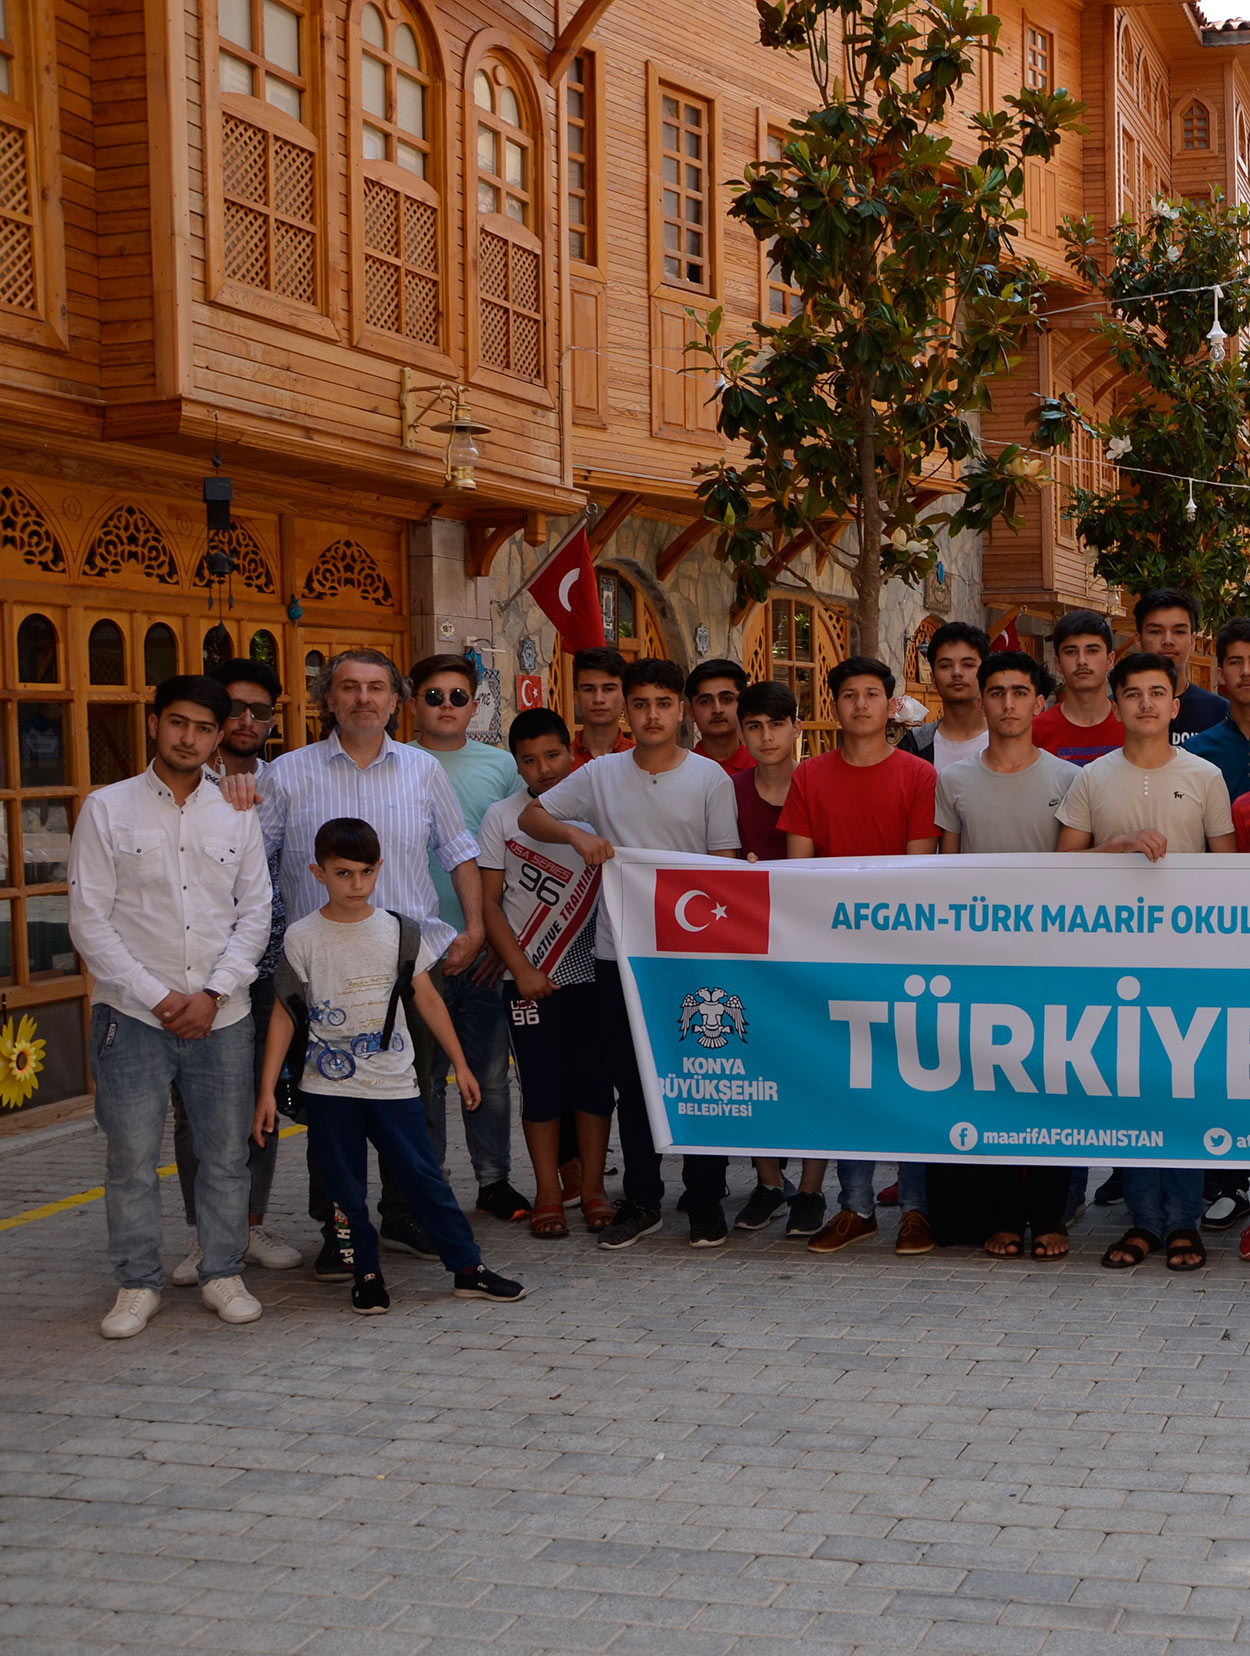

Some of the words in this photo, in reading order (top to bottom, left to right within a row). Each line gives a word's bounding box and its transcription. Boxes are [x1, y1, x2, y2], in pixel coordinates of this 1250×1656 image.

[510, 841, 530, 860] USA
[532, 854, 571, 881] SERIES
[518, 862, 566, 907] 96
[832, 896, 1034, 933] AFGAN-TÜRK
[1042, 897, 1165, 934] MAARİF
[512, 1008, 540, 1026] 96
[683, 1056, 746, 1075] KONYA
[678, 1101, 753, 1117] BELEDİYESİ
[983, 1128, 1164, 1147] maarifAFGHANISTAN
